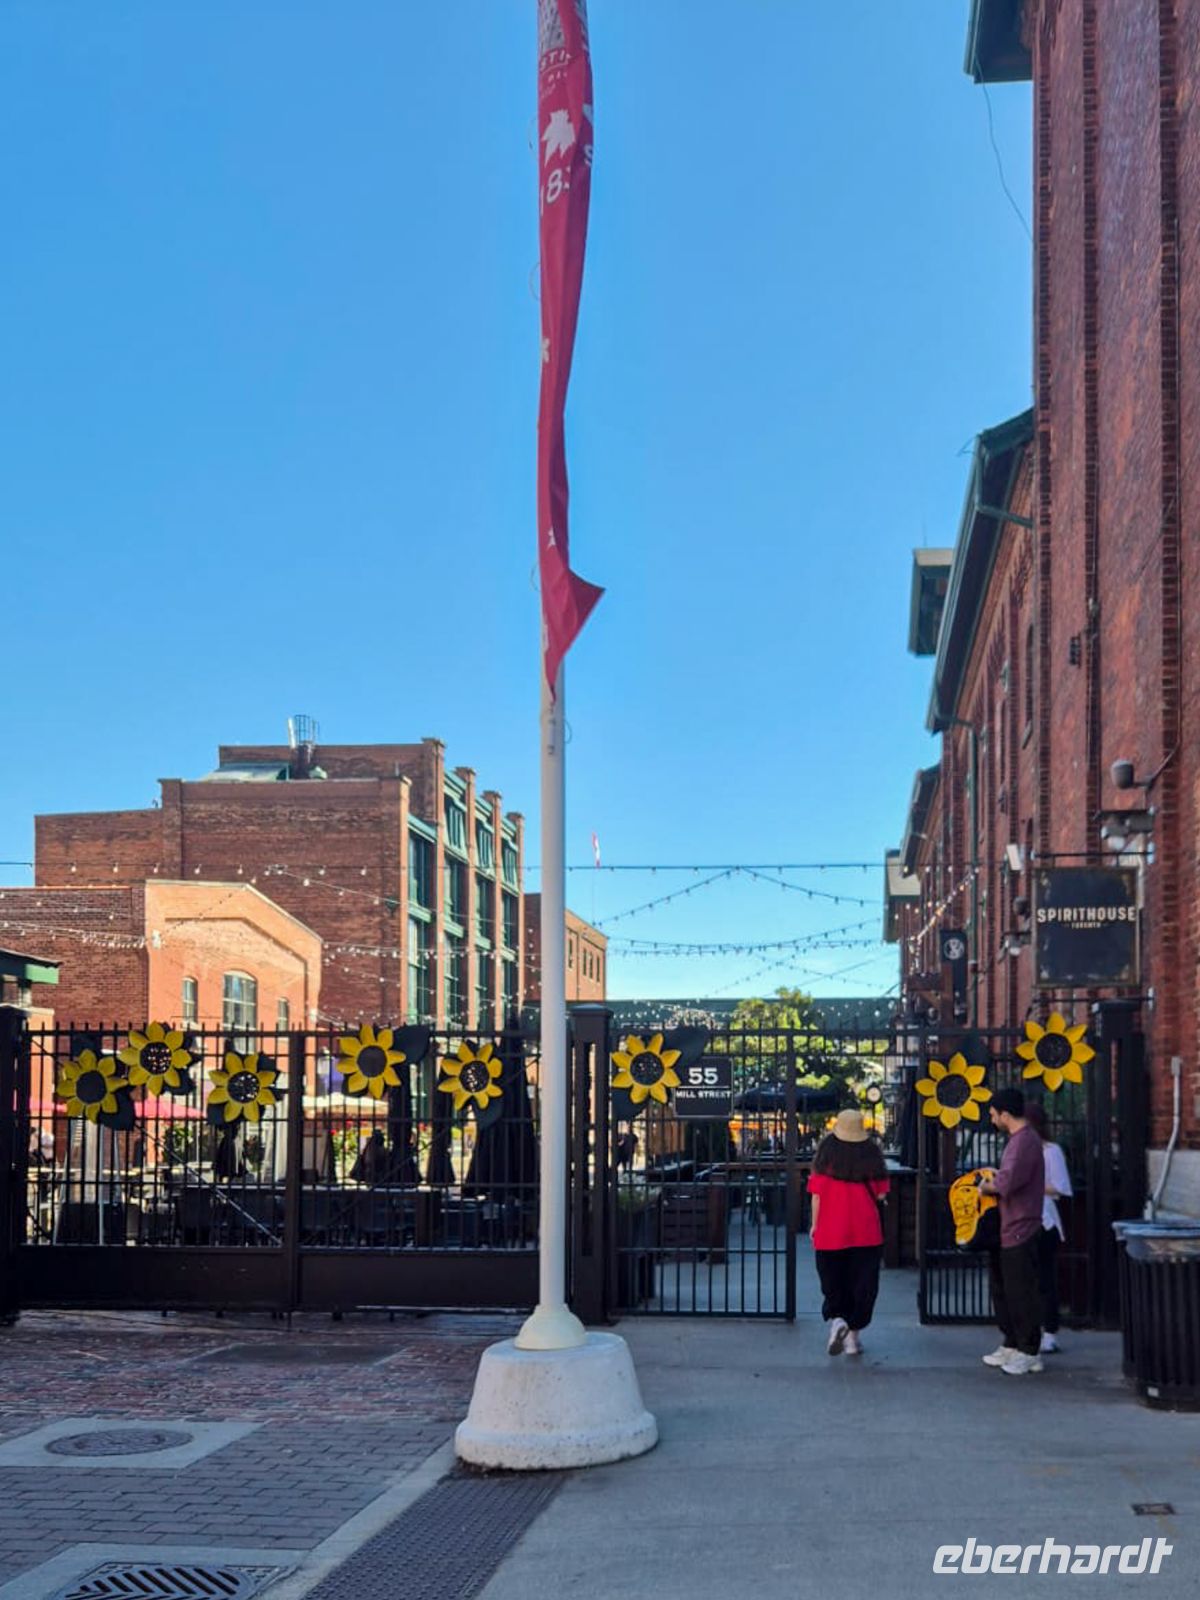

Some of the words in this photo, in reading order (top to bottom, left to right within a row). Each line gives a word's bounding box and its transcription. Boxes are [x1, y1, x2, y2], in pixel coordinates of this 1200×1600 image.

[1037, 907, 1136, 922] SPIRITHOUSE
[688, 1067, 719, 1085] 55
[676, 1090, 696, 1098] MILL
[698, 1090, 731, 1098] STREET
